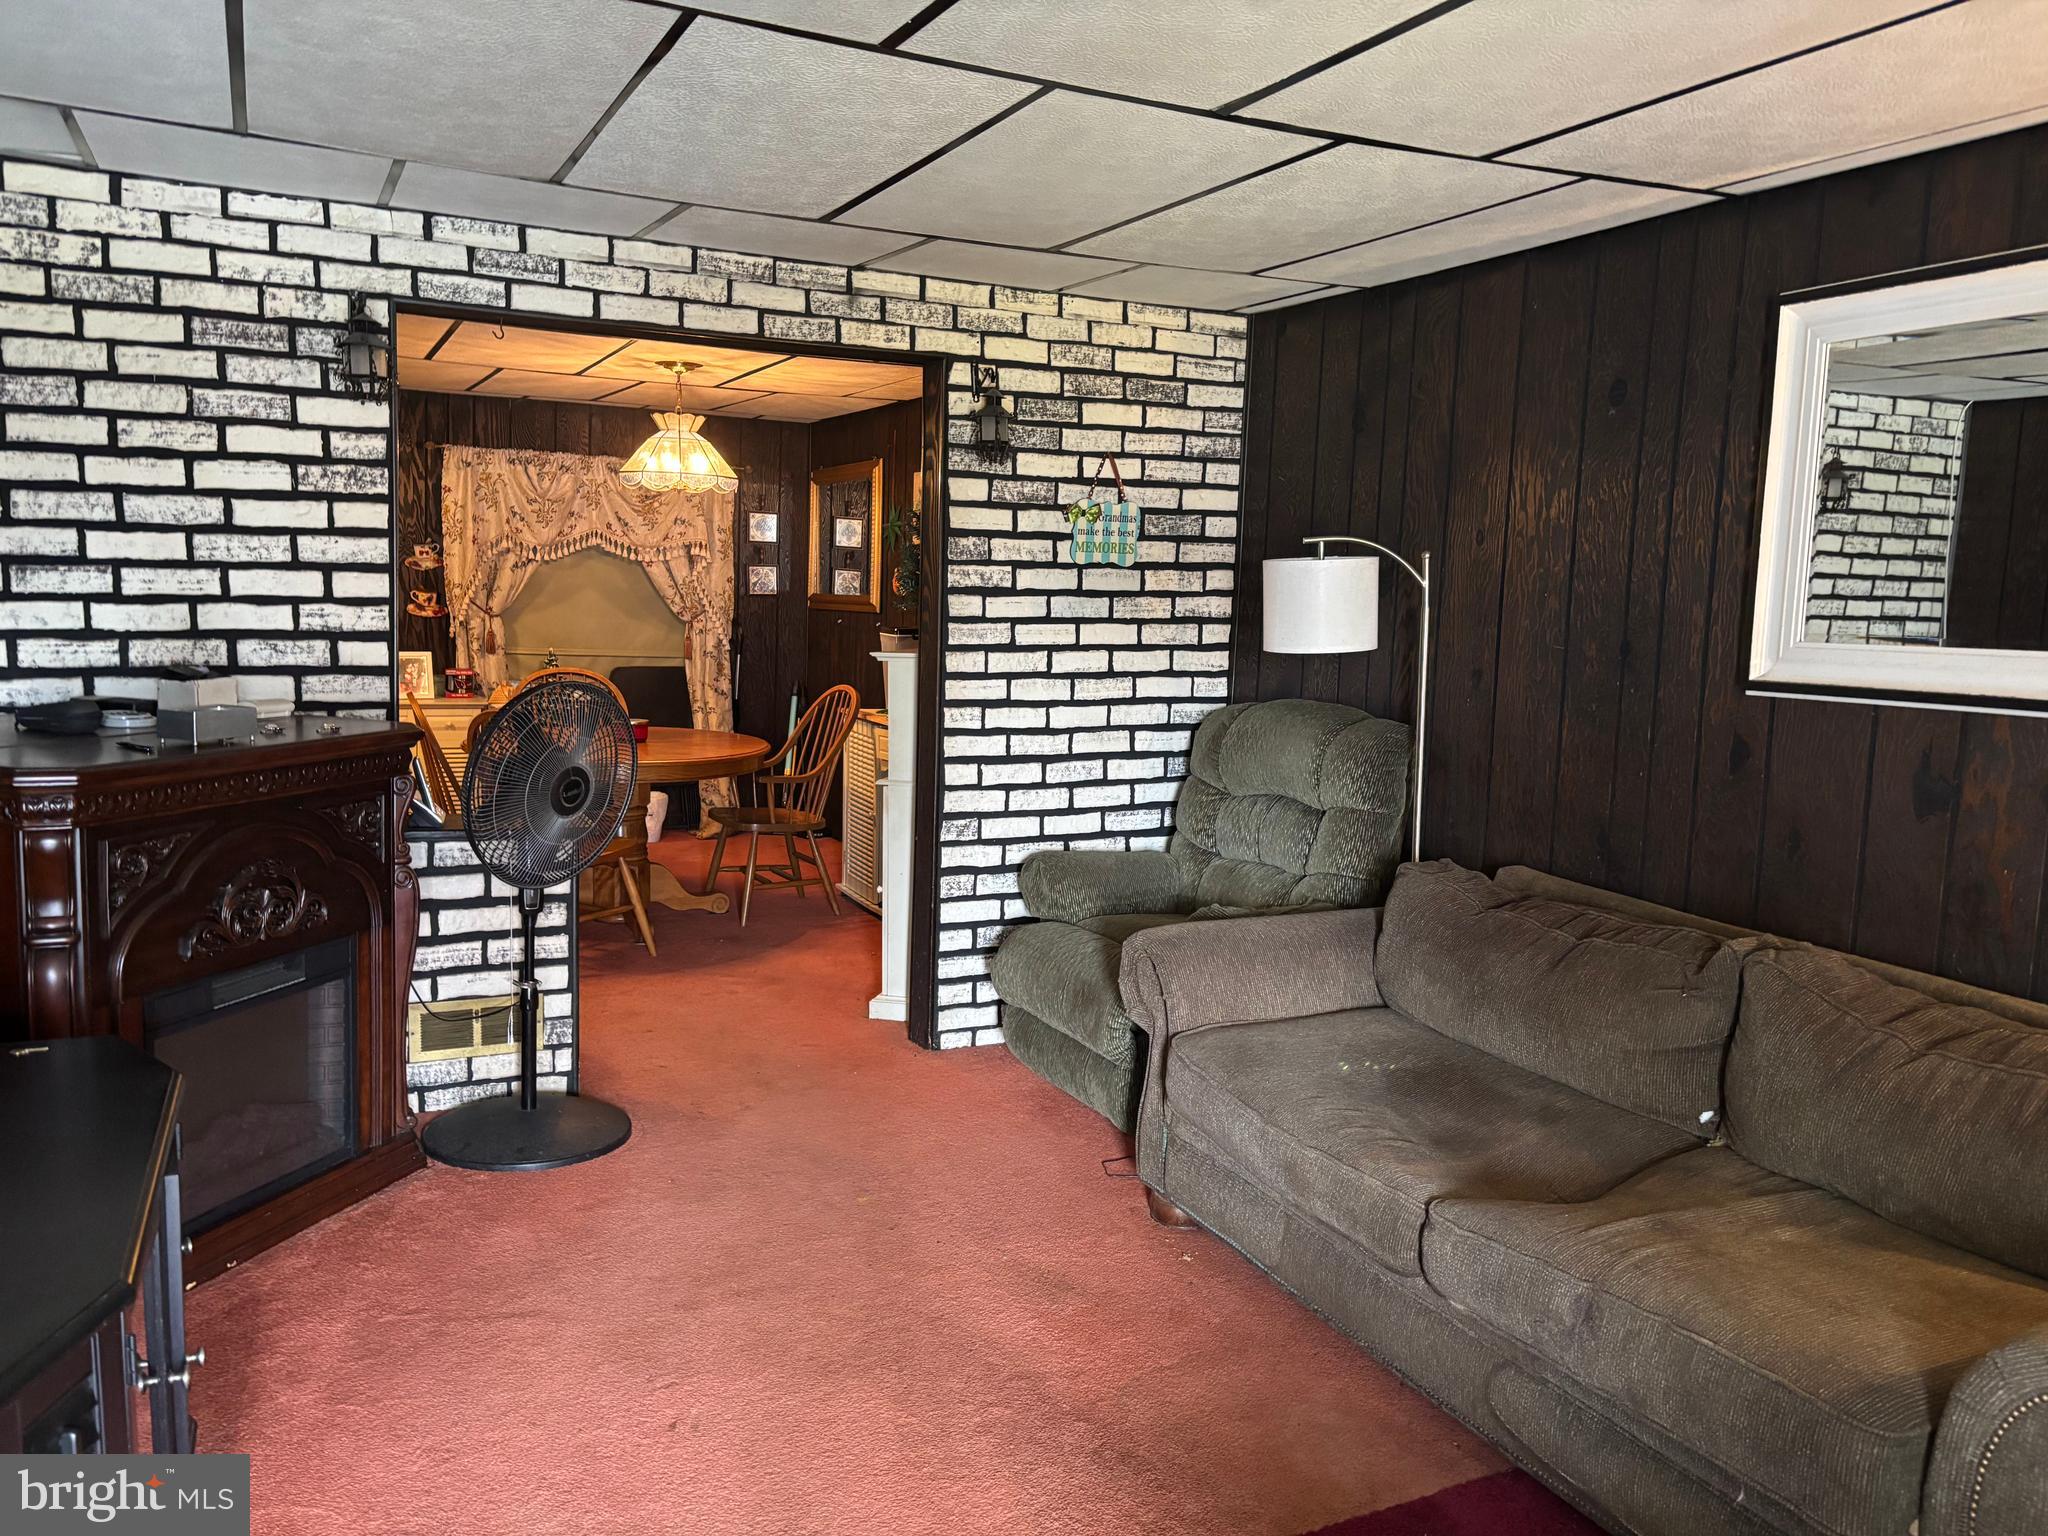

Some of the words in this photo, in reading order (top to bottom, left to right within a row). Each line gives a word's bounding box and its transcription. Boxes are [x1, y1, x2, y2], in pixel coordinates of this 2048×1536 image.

[1077, 526, 1099, 536] make
[1102, 527, 1116, 537] the
[1117, 527, 1135, 538] best
[1075, 541, 1135, 555] MEMORIES
